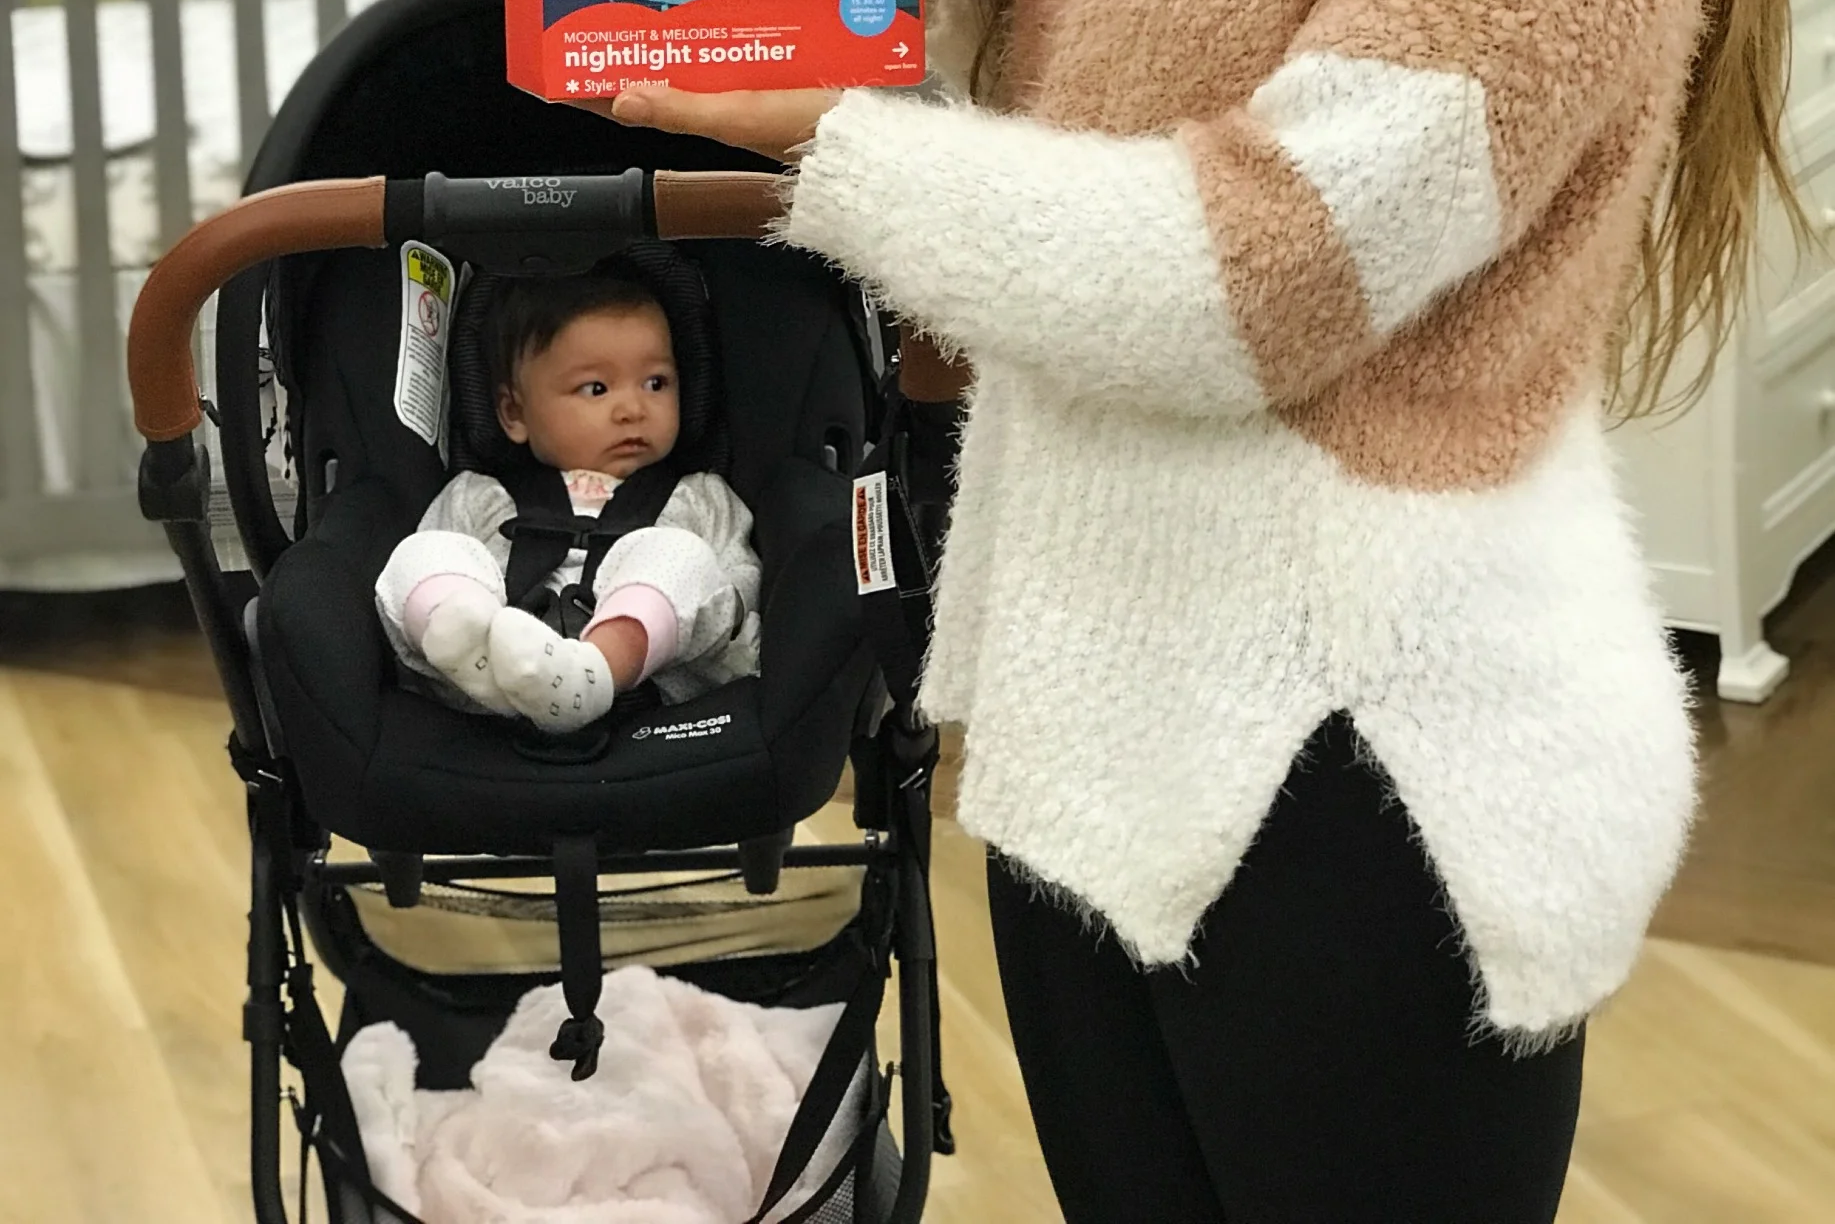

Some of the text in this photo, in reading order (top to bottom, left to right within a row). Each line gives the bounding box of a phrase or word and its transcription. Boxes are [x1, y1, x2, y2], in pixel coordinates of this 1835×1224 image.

[564, 29, 646, 44] MOONLIGHT
[650, 29, 660, 41] &
[662, 27, 728, 41] MELODIES
[565, 39, 796, 73] nightlight soother
[584, 79, 616, 95] Style:
[521, 187, 578, 208] baby
[857, 533, 867, 545] EN
[654, 715, 730, 734] MAXI-COSI
[665, 726, 722, 740] Mico Max 30
